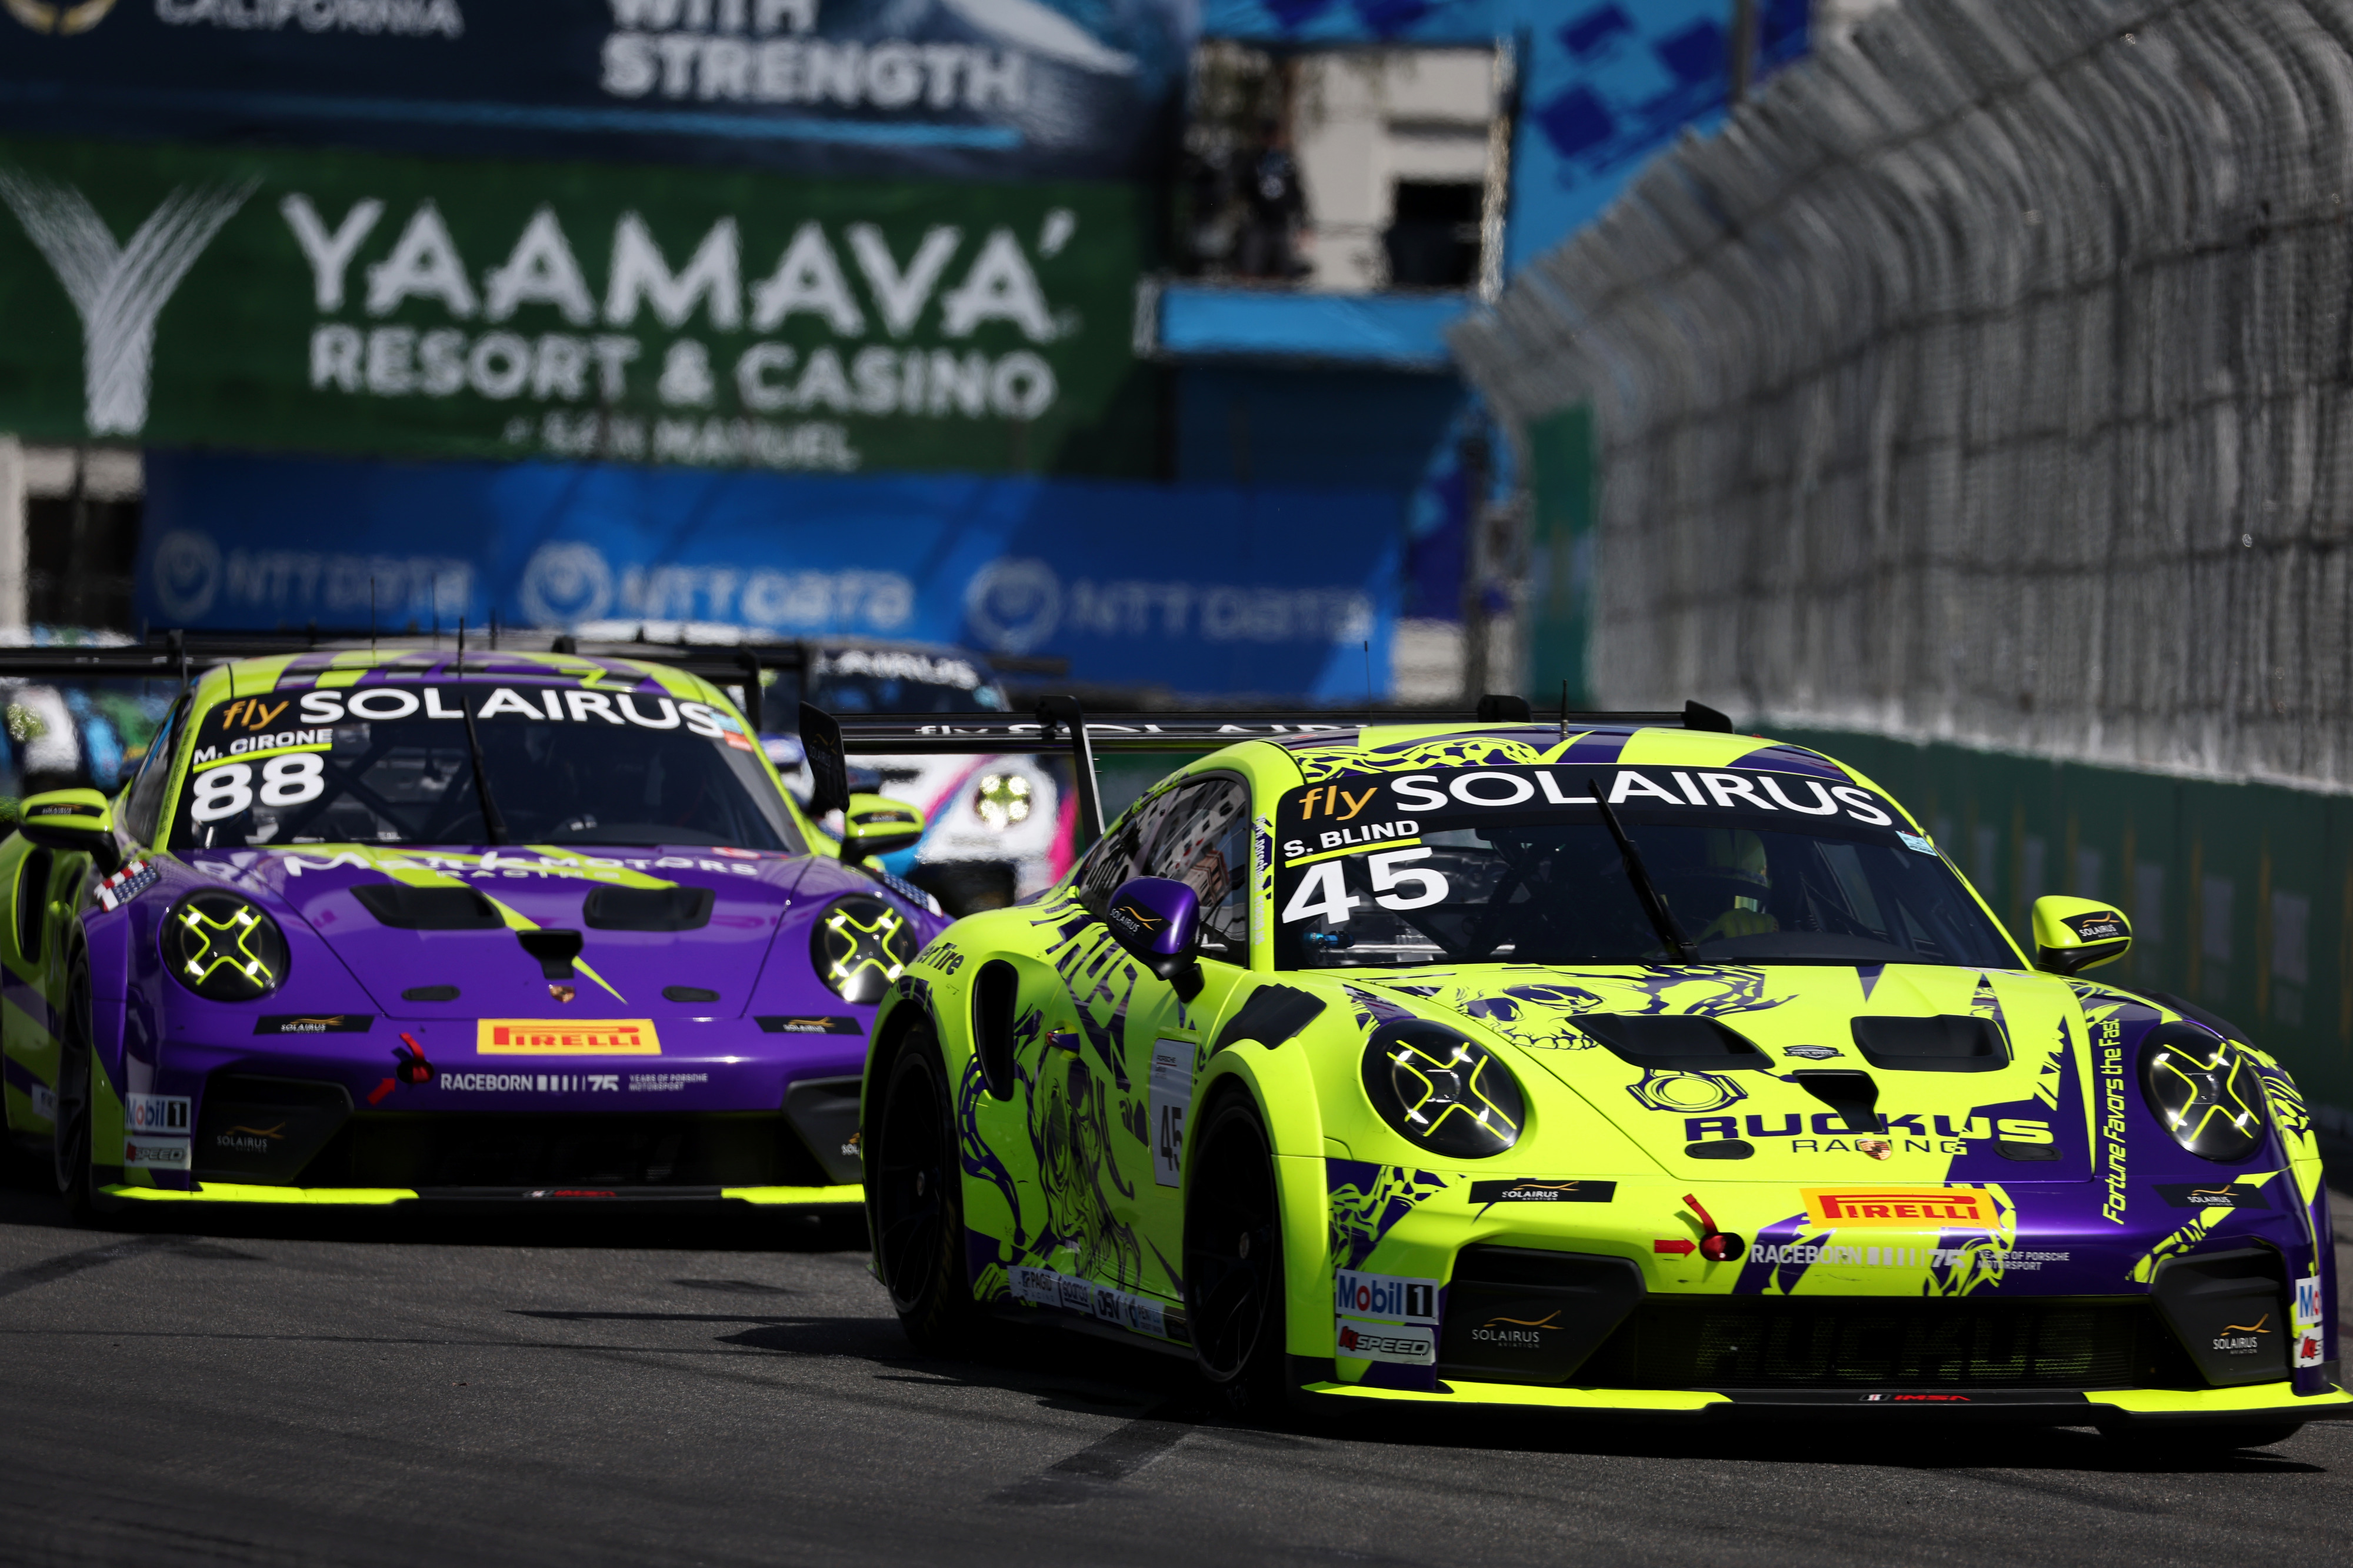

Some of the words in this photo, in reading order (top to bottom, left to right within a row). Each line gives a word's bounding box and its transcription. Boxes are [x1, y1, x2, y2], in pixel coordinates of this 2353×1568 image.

[600, 32, 1028, 109] STRENGTH
[308, 323, 640, 402] RESORT
[656, 338, 714, 409] &
[736, 339, 1057, 421] CASINO
[222, 698, 289, 730] fly
[300, 688, 725, 739] SOLAIRUS
[193, 748, 224, 765] M.
[229, 728, 333, 754] CIRONE
[191, 752, 325, 822] 88
[1298, 785, 1378, 821] fly
[1391, 770, 1892, 826] SOLAIRUS
[1284, 839, 1314, 858] S.
[1320, 820, 1419, 849] BLIND
[1282, 847, 1449, 925] 45
[1109, 908, 1140, 932] SOLAIRUS
[2078, 924, 2117, 937] SOLAIRUS
[494, 1026, 642, 1046] PIRELLI
[2098, 1018, 2121, 1047] Fast
[2099, 1048, 2123, 1075] the
[441, 1073, 533, 1092] RACEBORN
[588, 1075, 619, 1092] 75
[125, 1096, 166, 1127] Mobil
[173, 1101, 181, 1126] 1
[2102, 1078, 2127, 1143] Favors
[216, 1135, 268, 1148] SOLAIRUS
[1684, 1112, 2055, 1145] RUCKUS
[1792, 1139, 1968, 1155] RANG
[2102, 1143, 2127, 1225] Fortune
[1818, 1194, 1981, 1220] PIRELLI
[2187, 1196, 2231, 1204] SOLAIRUS
[1750, 1245, 1862, 1266] RACEBORN
[1927, 1249, 1968, 1269] 75
[1976, 1259, 2042, 1272] MOTORSPORT
[1977, 1249, 2010, 1260] YEARS
[2011, 1252, 2024, 1260] OF
[2026, 1252, 2071, 1262] PORSCHE
[1338, 1275, 1402, 1316] Mobil
[1413, 1285, 1426, 1316] 1
[1471, 1328, 1540, 1343] SOLAIRUS
[2212, 1336, 2258, 1350] SOLAIRUS
